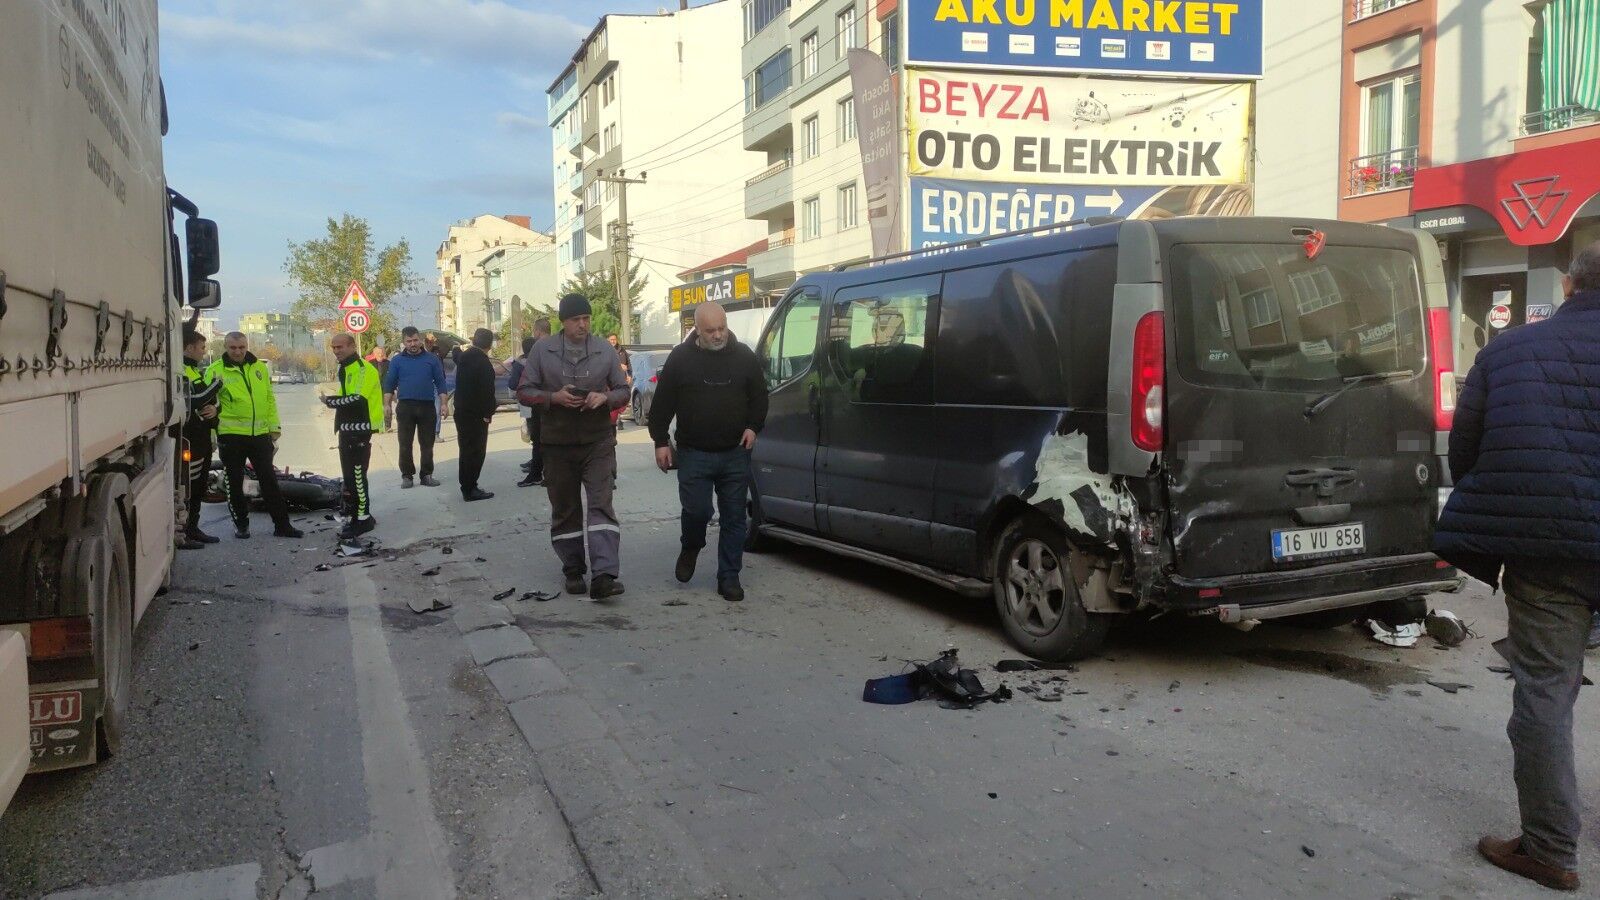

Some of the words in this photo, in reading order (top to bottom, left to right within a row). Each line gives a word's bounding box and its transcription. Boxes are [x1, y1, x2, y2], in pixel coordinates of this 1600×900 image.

[1049, 0, 1239, 35] MARKET
[918, 78, 1050, 122] BEYZA
[917, 129, 1001, 171] OTO
[921, 188, 1075, 237] ERDEĞER
[1439, 216, 1466, 227] GLOBAL
[683, 280, 732, 305] SUNCAR
[350, 316, 365, 327] 50
[1285, 533, 1301, 552] 16
[1310, 531, 1328, 549] VU
[1336, 528, 1361, 547] 858
[30, 696, 76, 721] LU
